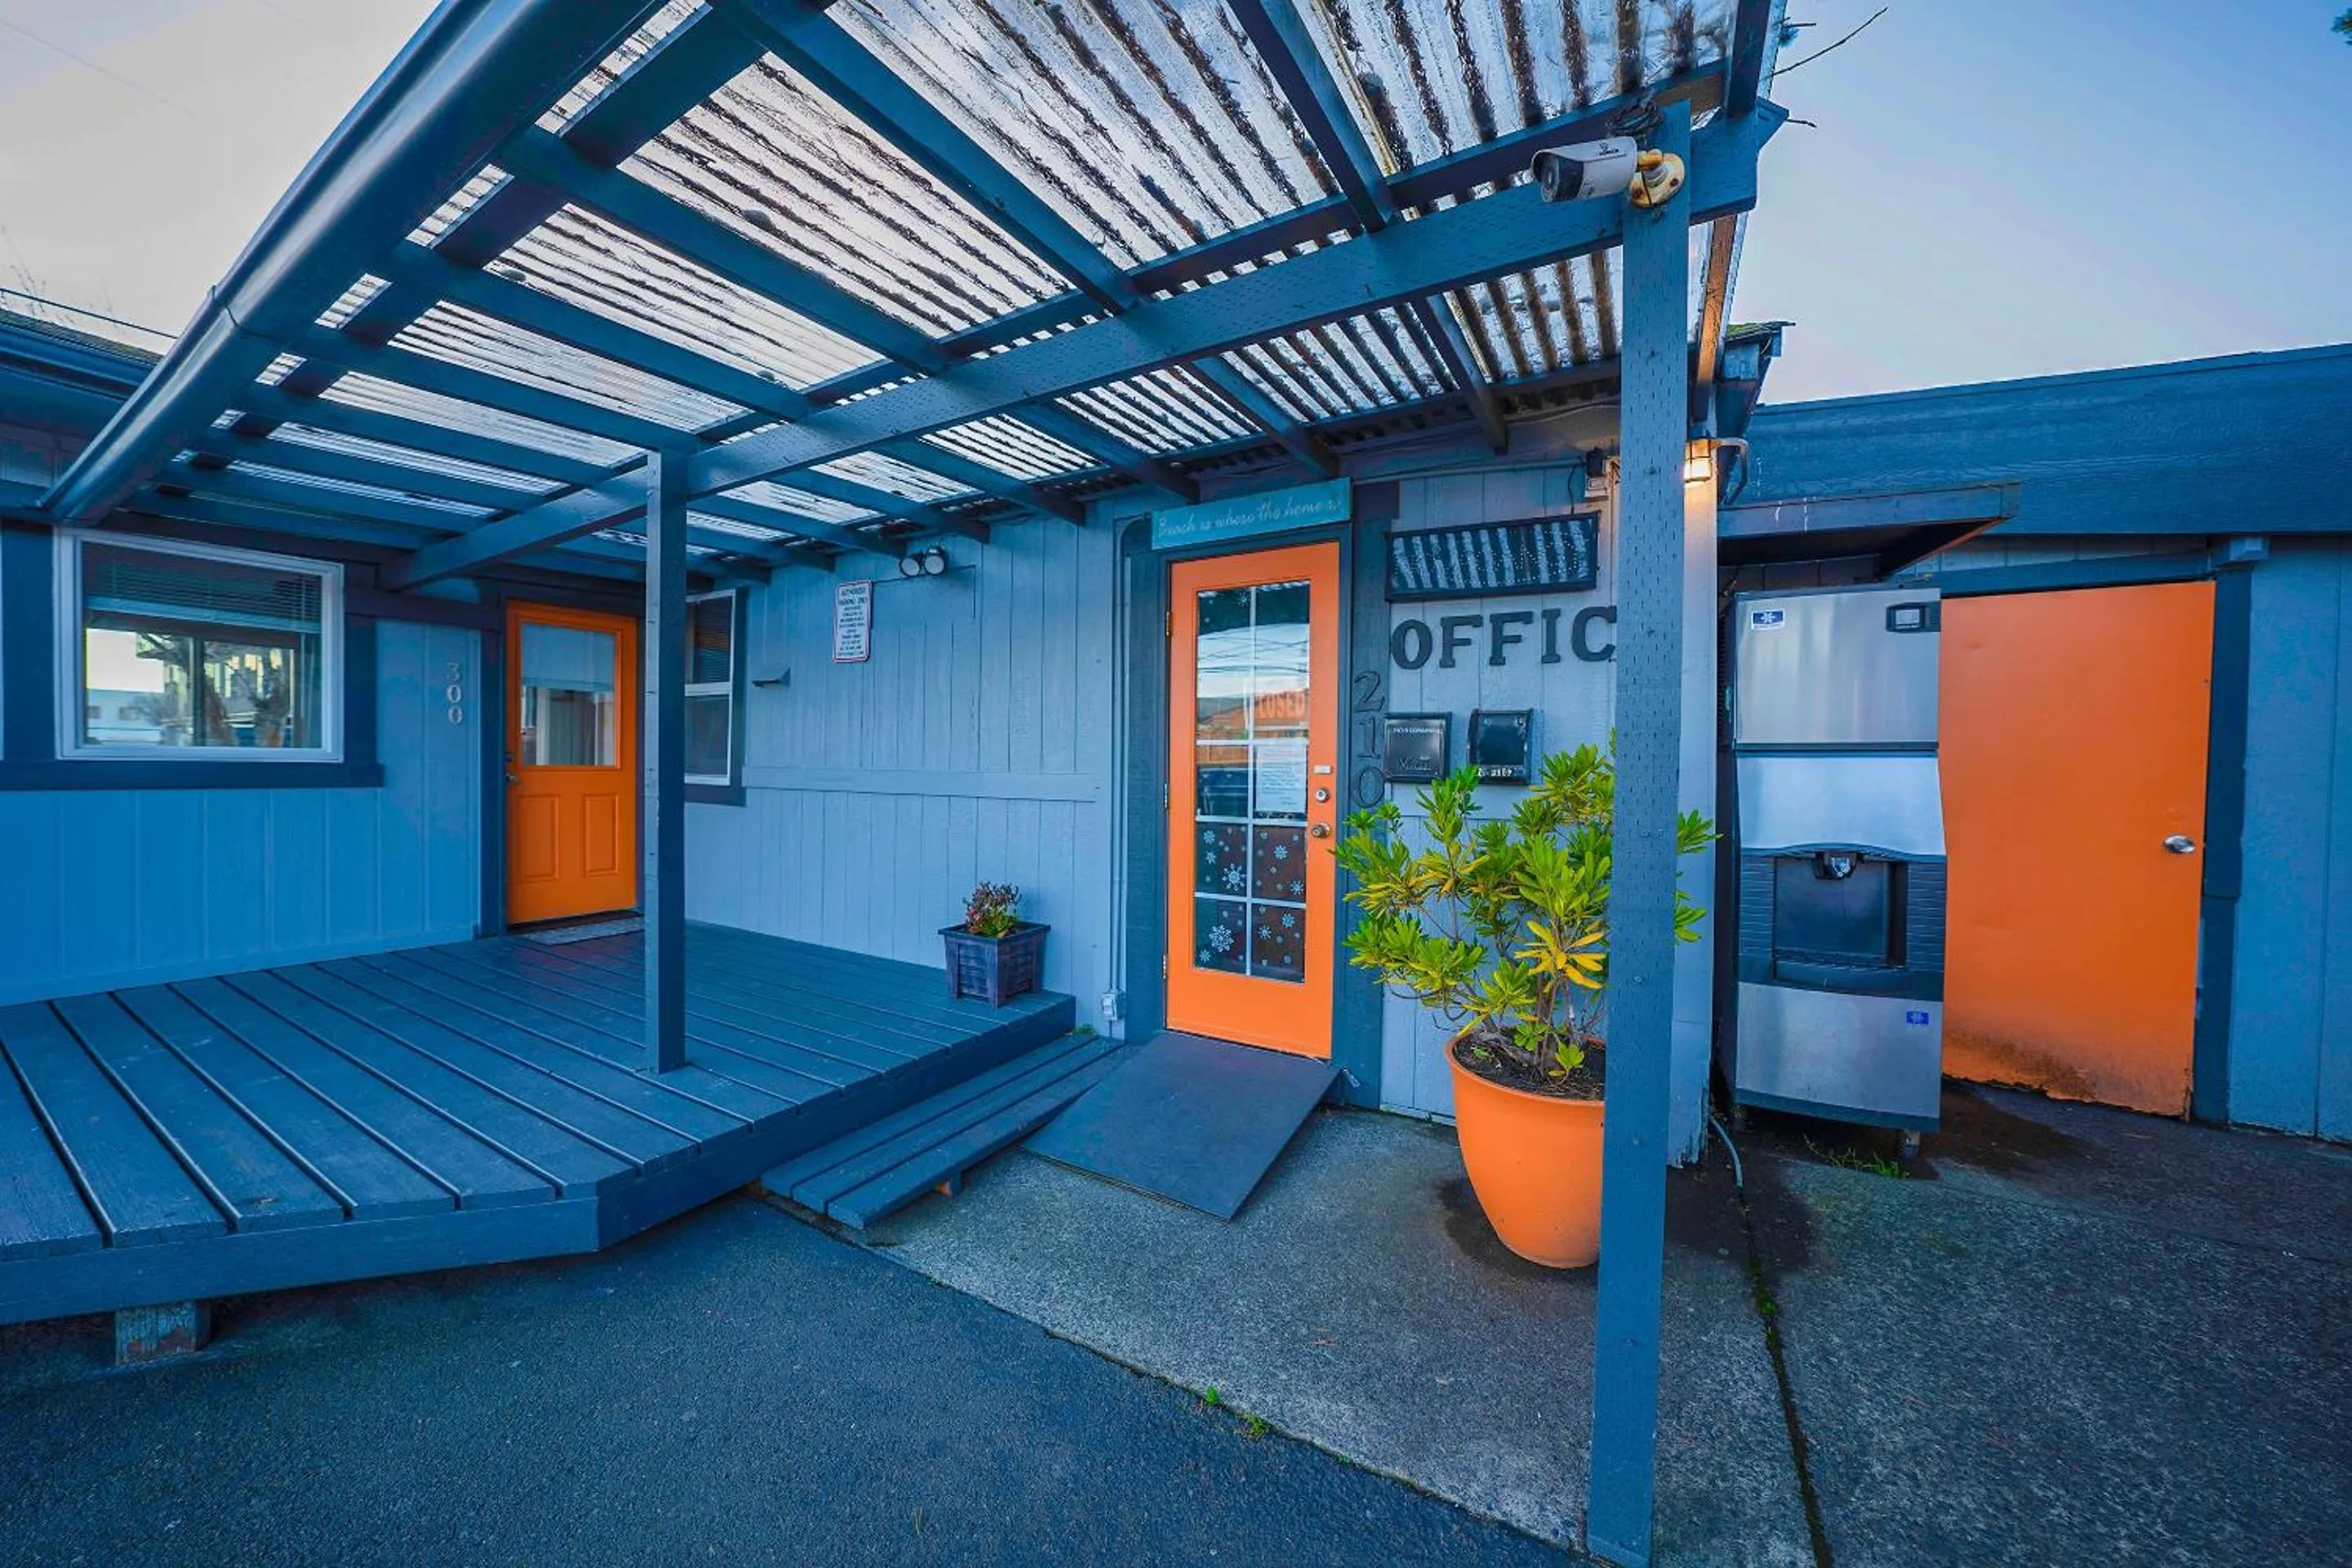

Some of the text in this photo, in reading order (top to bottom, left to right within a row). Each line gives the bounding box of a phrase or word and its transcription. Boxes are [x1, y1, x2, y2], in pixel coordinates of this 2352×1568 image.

[1391, 605, 1617, 670] OFFIC
[447, 662, 462, 724] 300
[1255, 691, 1306, 719] LOSED
[1351, 670, 1386, 808] 210
